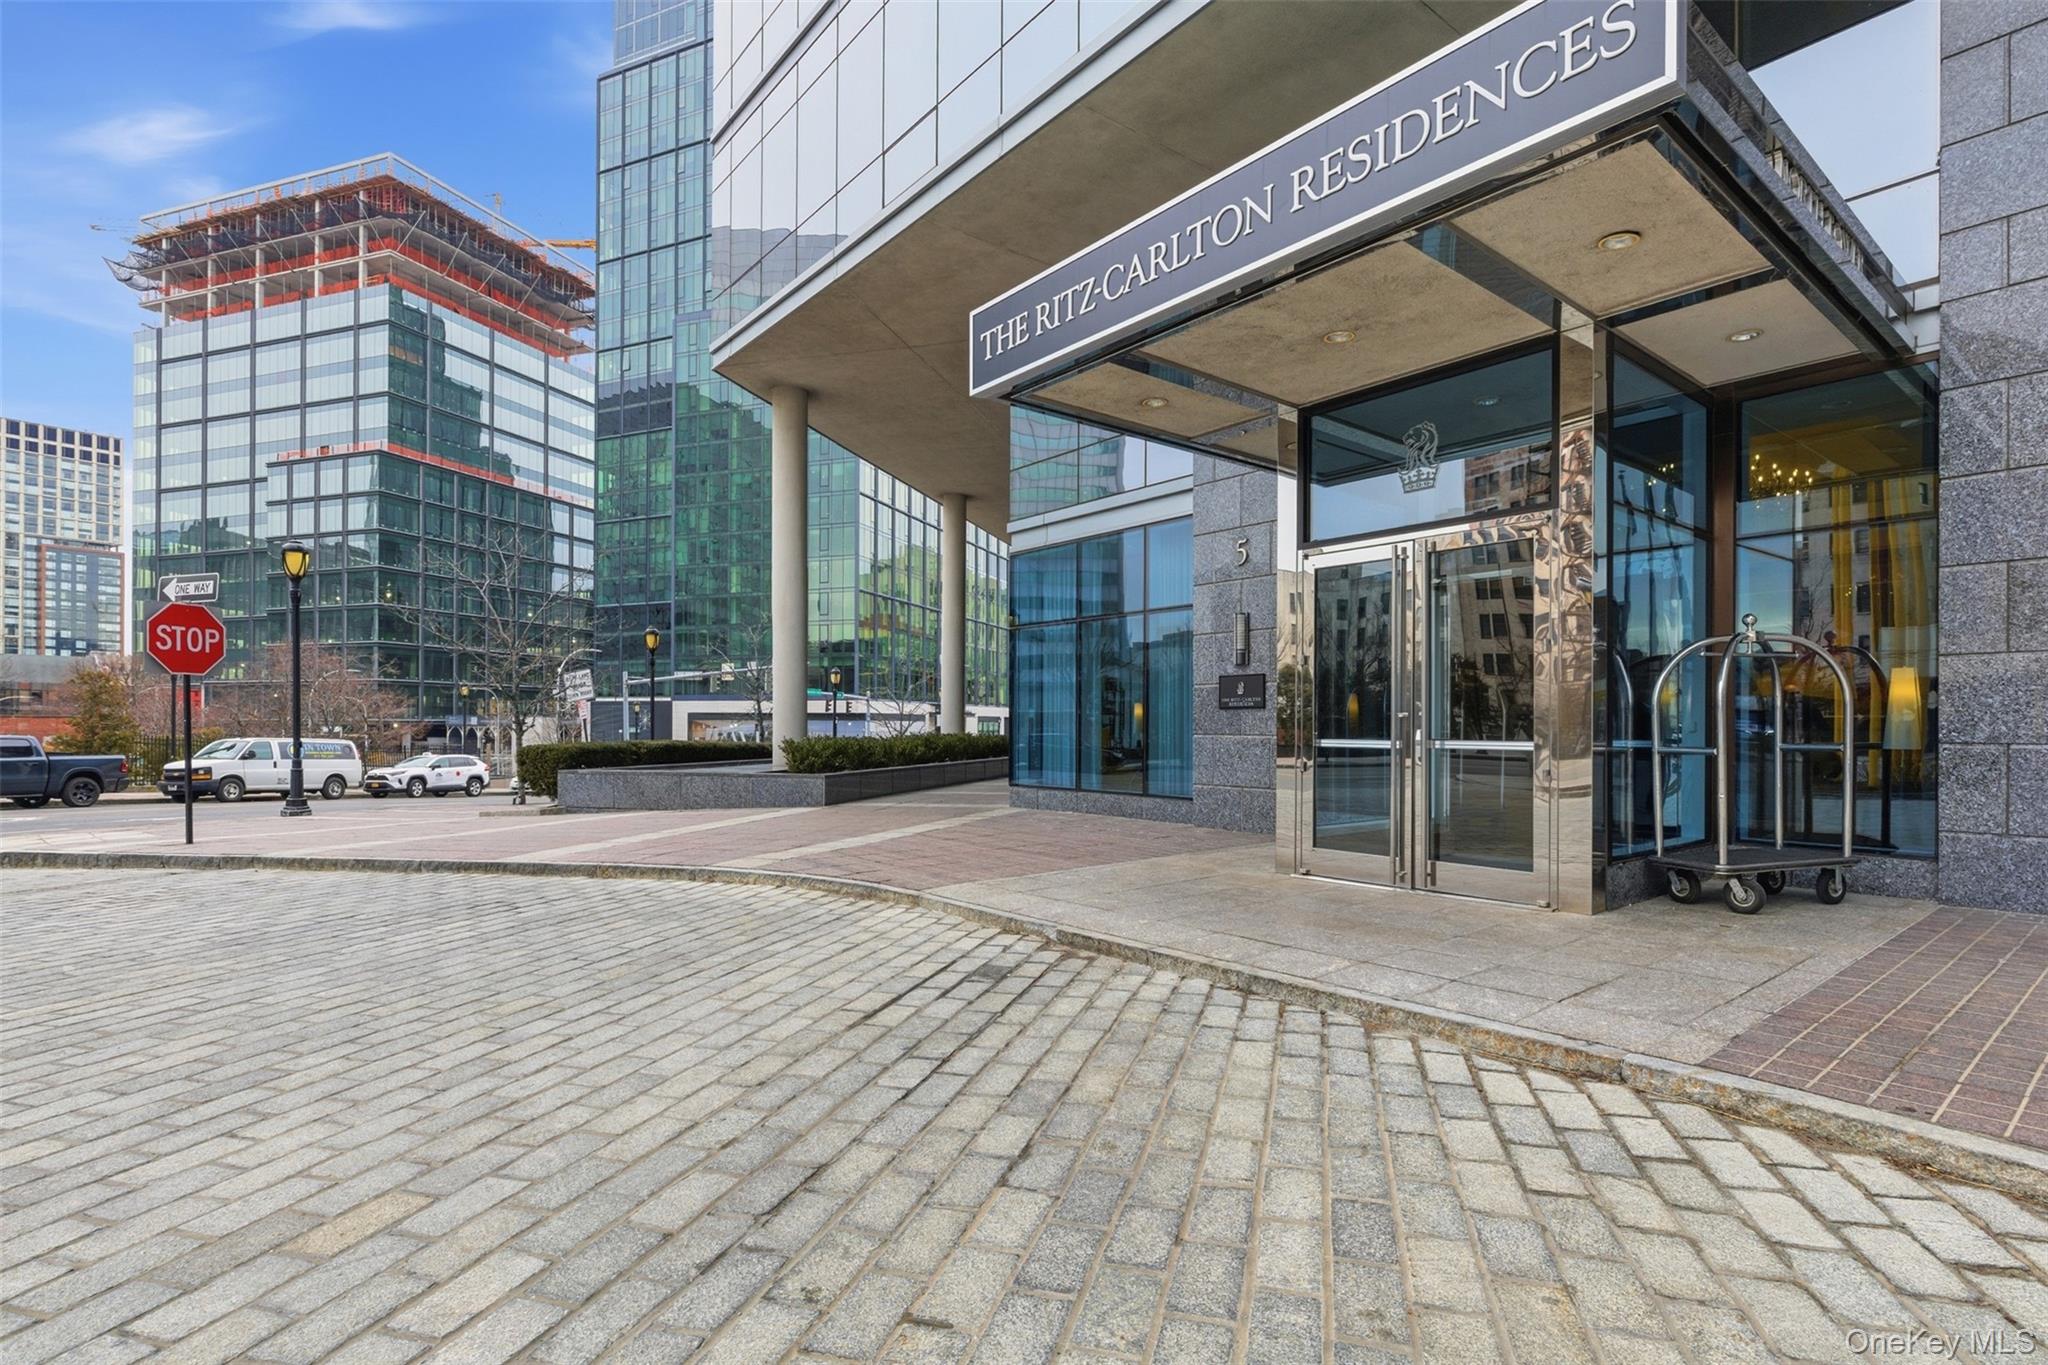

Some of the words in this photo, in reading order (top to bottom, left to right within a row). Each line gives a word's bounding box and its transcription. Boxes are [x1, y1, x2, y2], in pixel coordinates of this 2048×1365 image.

[980, 312, 1030, 361] THE
[1034, 182, 1274, 336] RITZ-CARLTON
[1289, 0, 1638, 214] RESIDENCES
[1237, 538, 1248, 567] 5
[174, 584, 191, 595] ONE
[194, 582, 212, 593] WAY
[155, 624, 220, 653] STOP
[316, 743, 342, 752] TOWN
